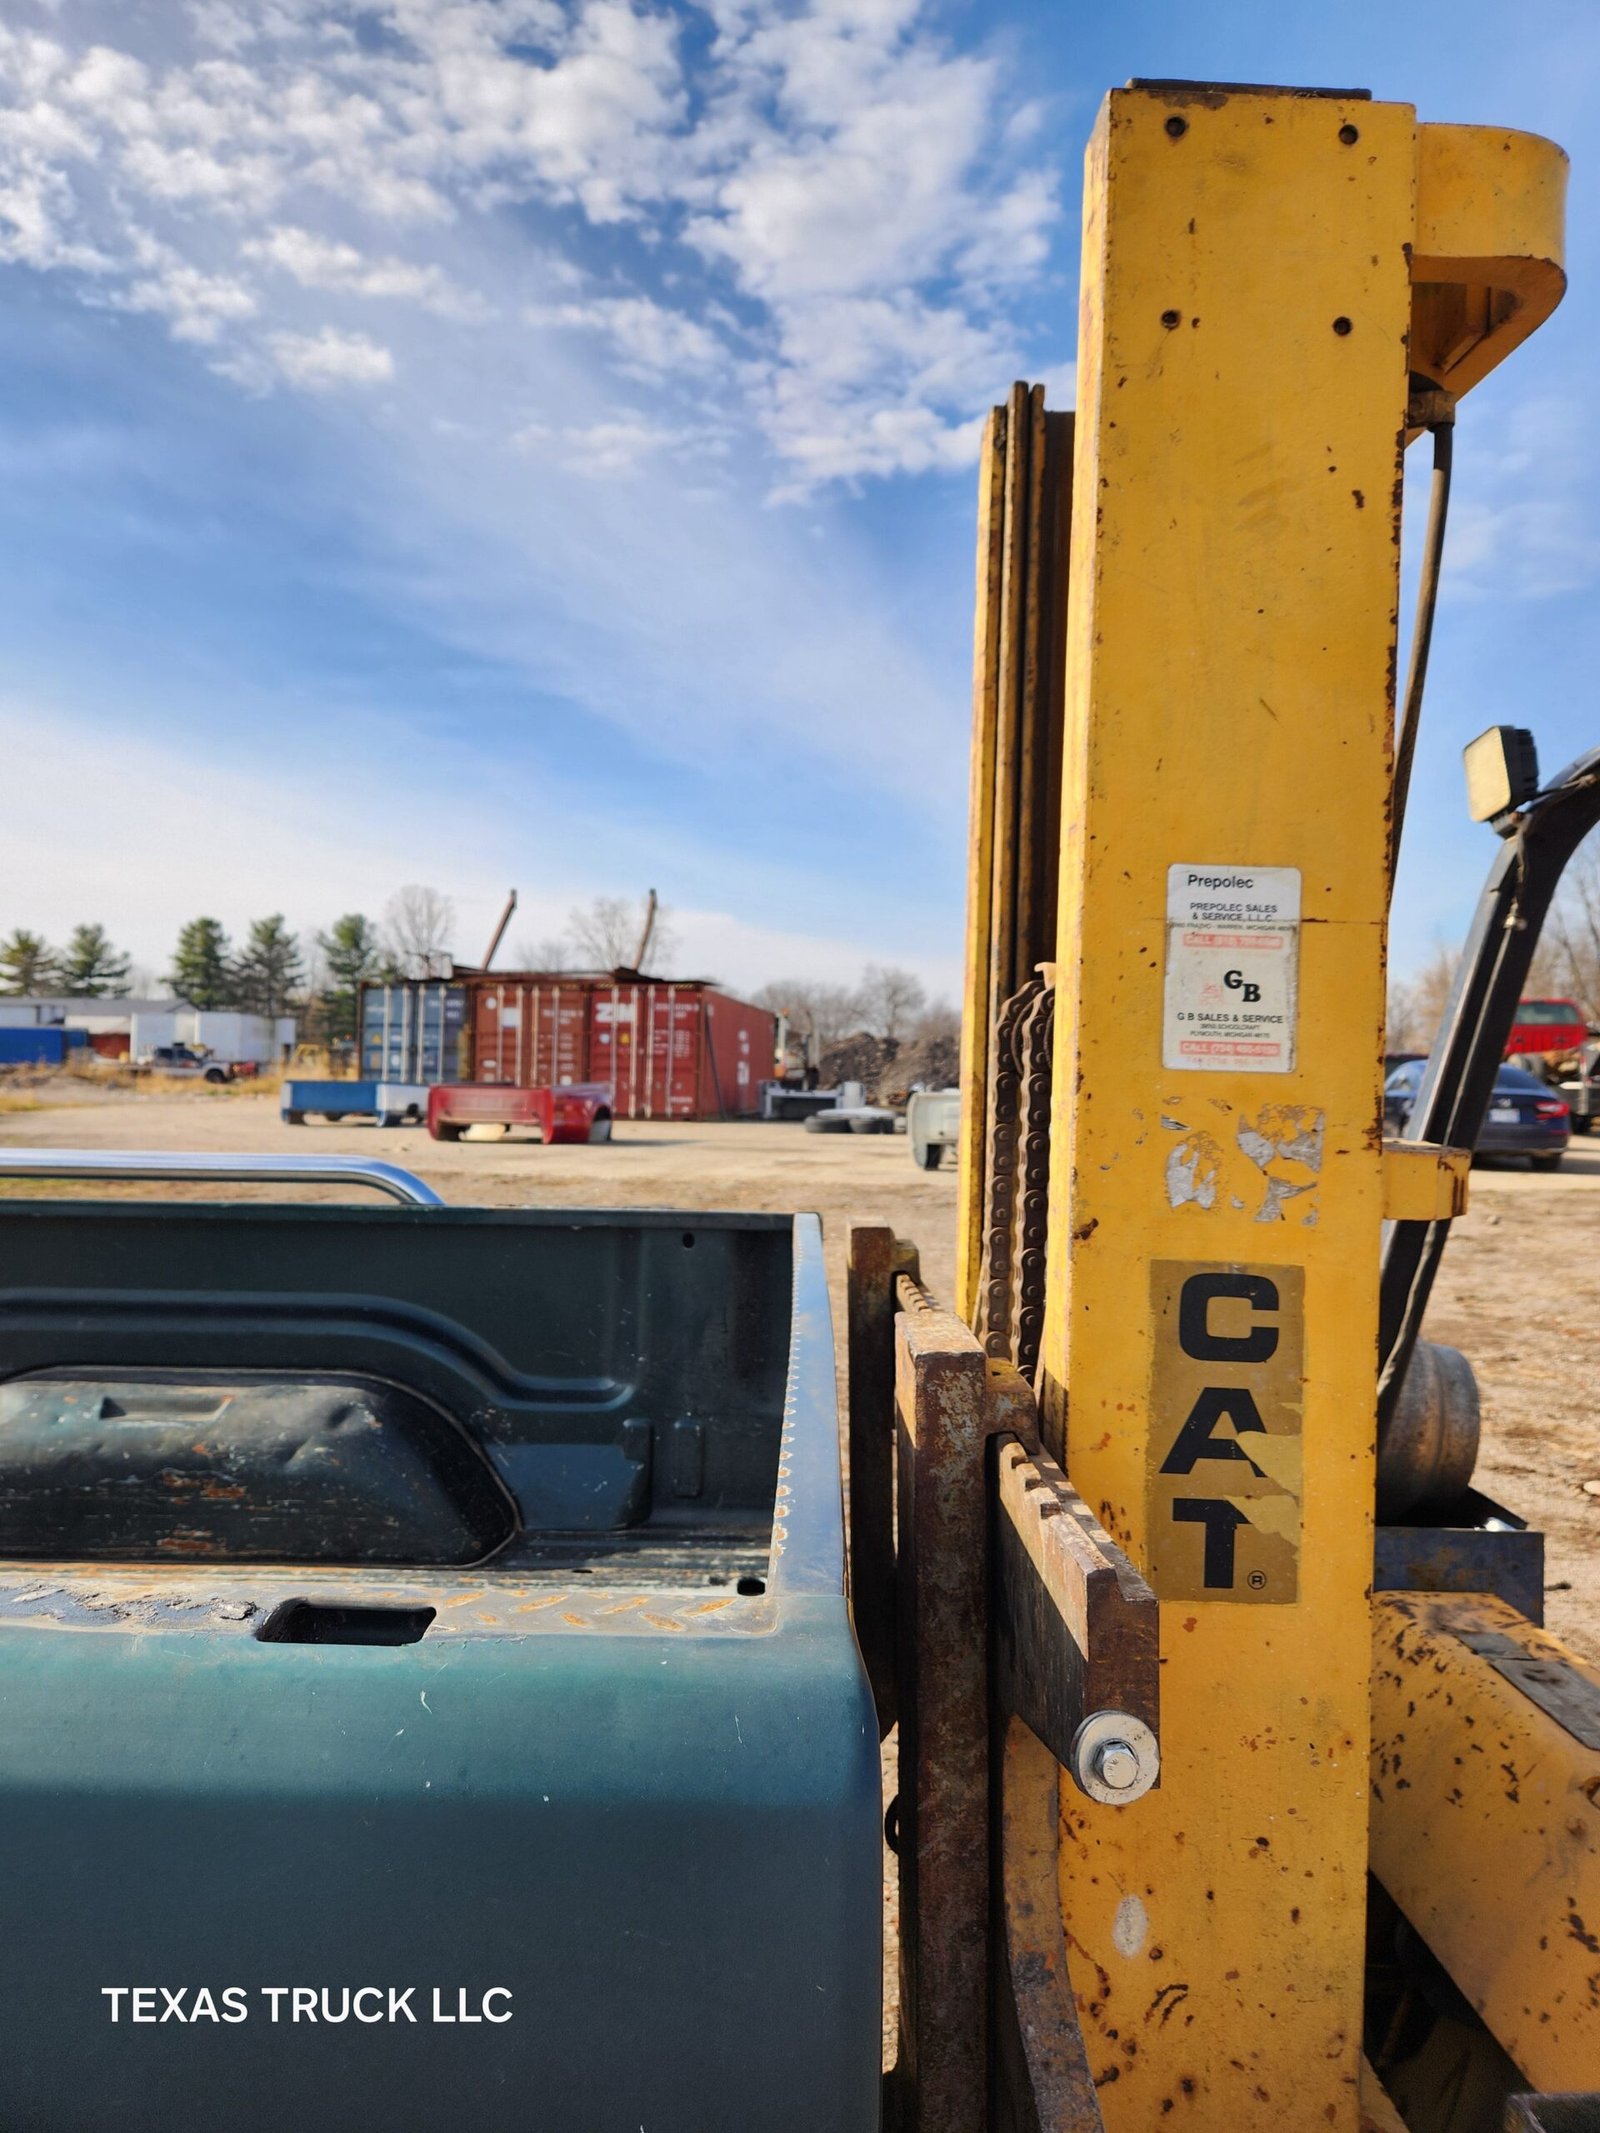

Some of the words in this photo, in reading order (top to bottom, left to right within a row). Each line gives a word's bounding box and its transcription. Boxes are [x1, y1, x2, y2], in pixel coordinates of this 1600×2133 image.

[1187, 874, 1254, 890] Prepolec
[1190, 902, 1243, 912] PREPOLEC
[1245, 904, 1278, 913] SALES
[1192, 912, 1198, 920] &
[1197, 1013, 1229, 1022] SALES
[1232, 1014, 1239, 1022] &
[1242, 1014, 1283, 1024] SERVICE
[1159, 1273, 1279, 1589] CAT
